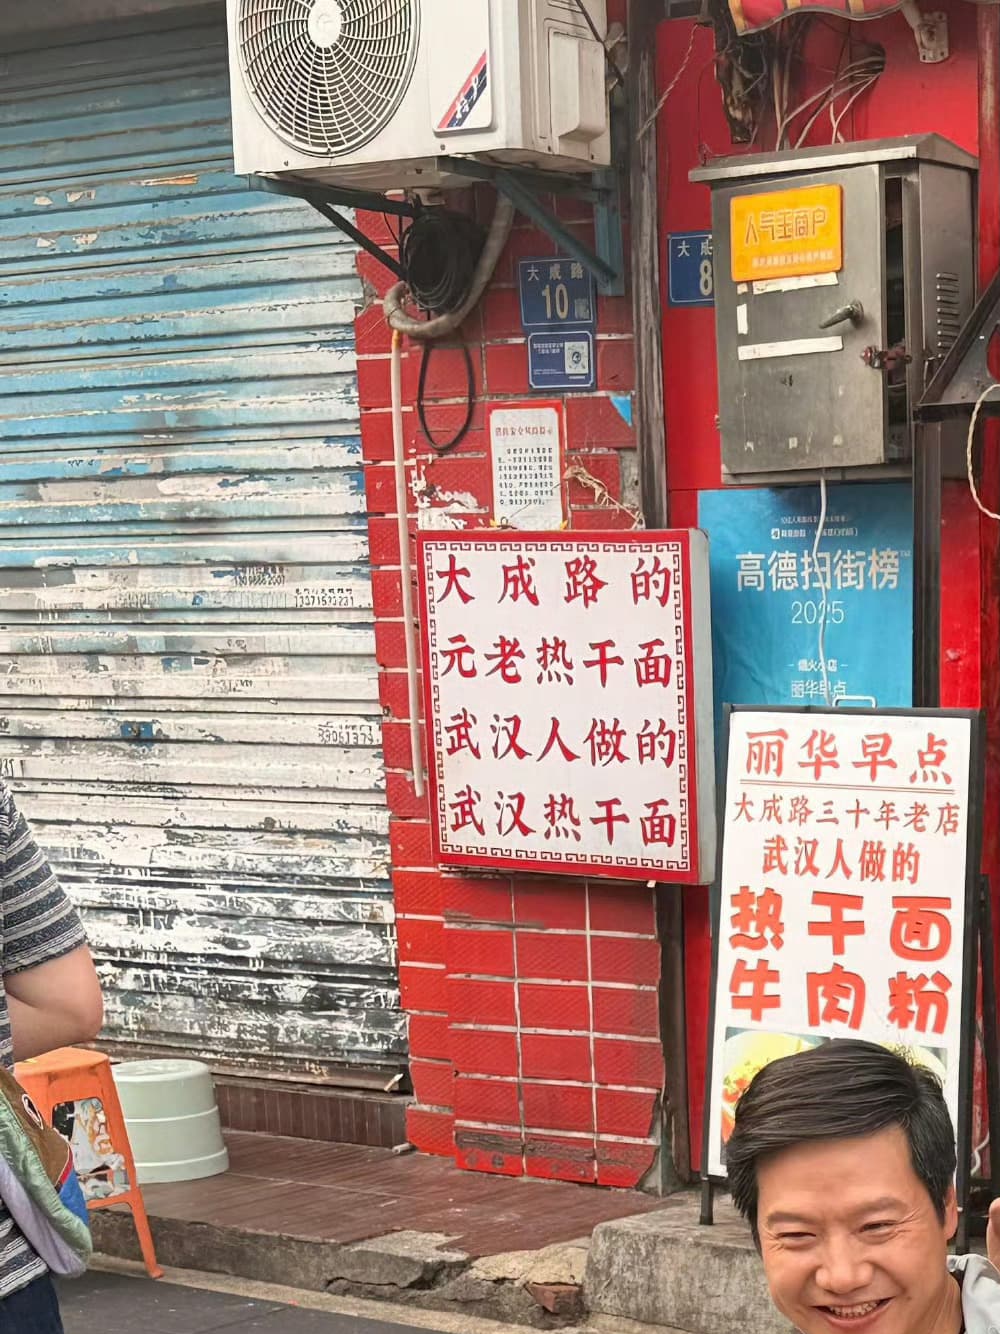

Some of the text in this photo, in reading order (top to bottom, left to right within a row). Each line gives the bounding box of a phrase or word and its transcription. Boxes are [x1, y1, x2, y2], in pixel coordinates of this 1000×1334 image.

[744, 208, 827, 244] 人气王商户
[527, 263, 585, 282] 大成路
[541, 283, 570, 320] 10
[436, 554, 672, 608] 大成路的
[735, 548, 900, 592] 高德扫街榜
[791, 600, 845, 625] 2025
[440, 634, 674, 689] 元老热干面
[444, 707, 677, 769] 武汉人做的
[745, 728, 954, 785] 丽华早点
[449, 784, 677, 848] 武汉热干面
[733, 792, 962, 837] 大成路三十年老店
[761, 836, 922, 885] 武汉人做的
[728, 884, 953, 963] 热干面
[728, 958, 953, 1036] 牛肉粉
